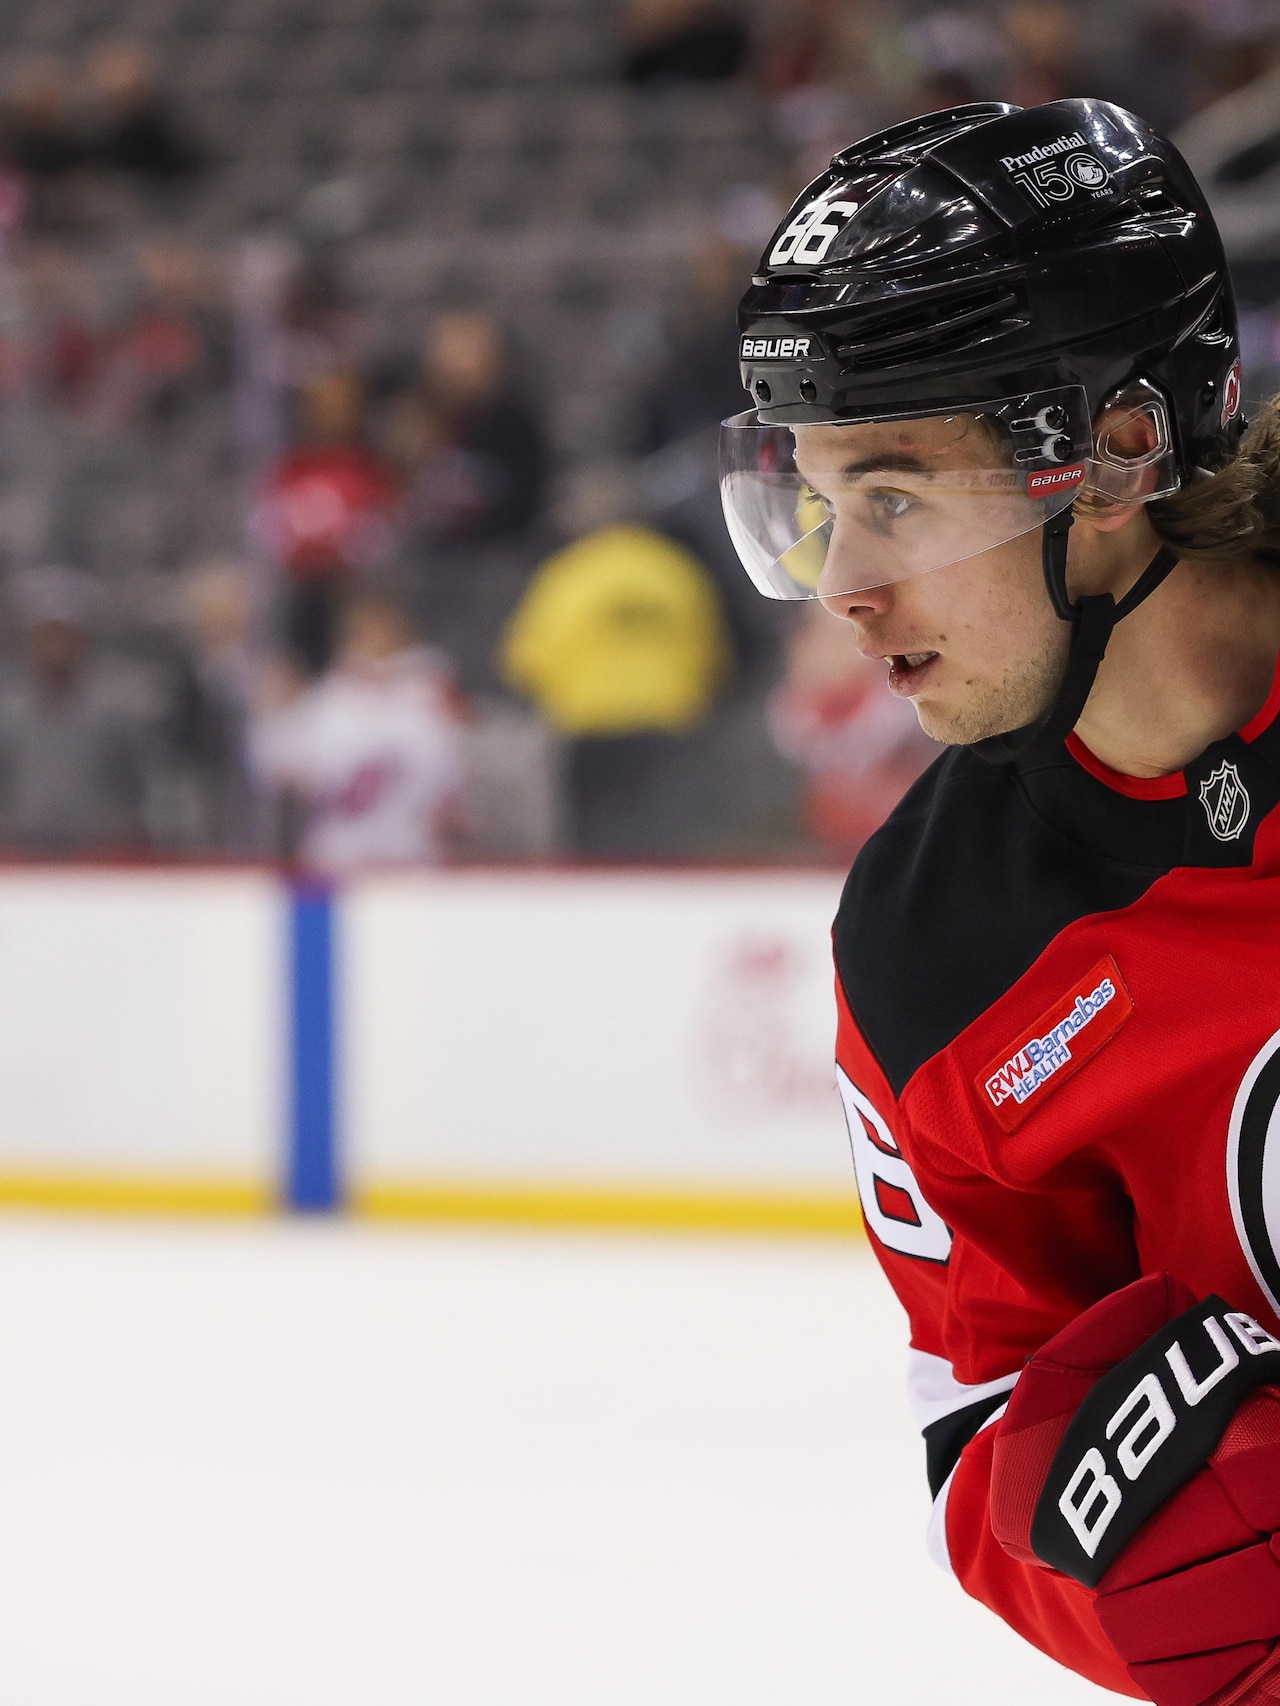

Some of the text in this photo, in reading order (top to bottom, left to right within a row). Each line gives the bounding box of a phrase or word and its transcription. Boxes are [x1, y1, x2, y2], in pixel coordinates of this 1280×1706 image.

[999, 131, 1088, 172] Prudential
[1014, 152, 1109, 208] 150
[1090, 187, 1114, 199] YEARS
[769, 201, 858, 266] 86
[742, 338, 811, 357] BAUER
[1031, 469, 1082, 487] BAUER
[1218, 783, 1236, 831] NHL
[986, 979, 1115, 1106] RWJBarnabas
[1012, 1044, 1072, 1104] HEALTH
